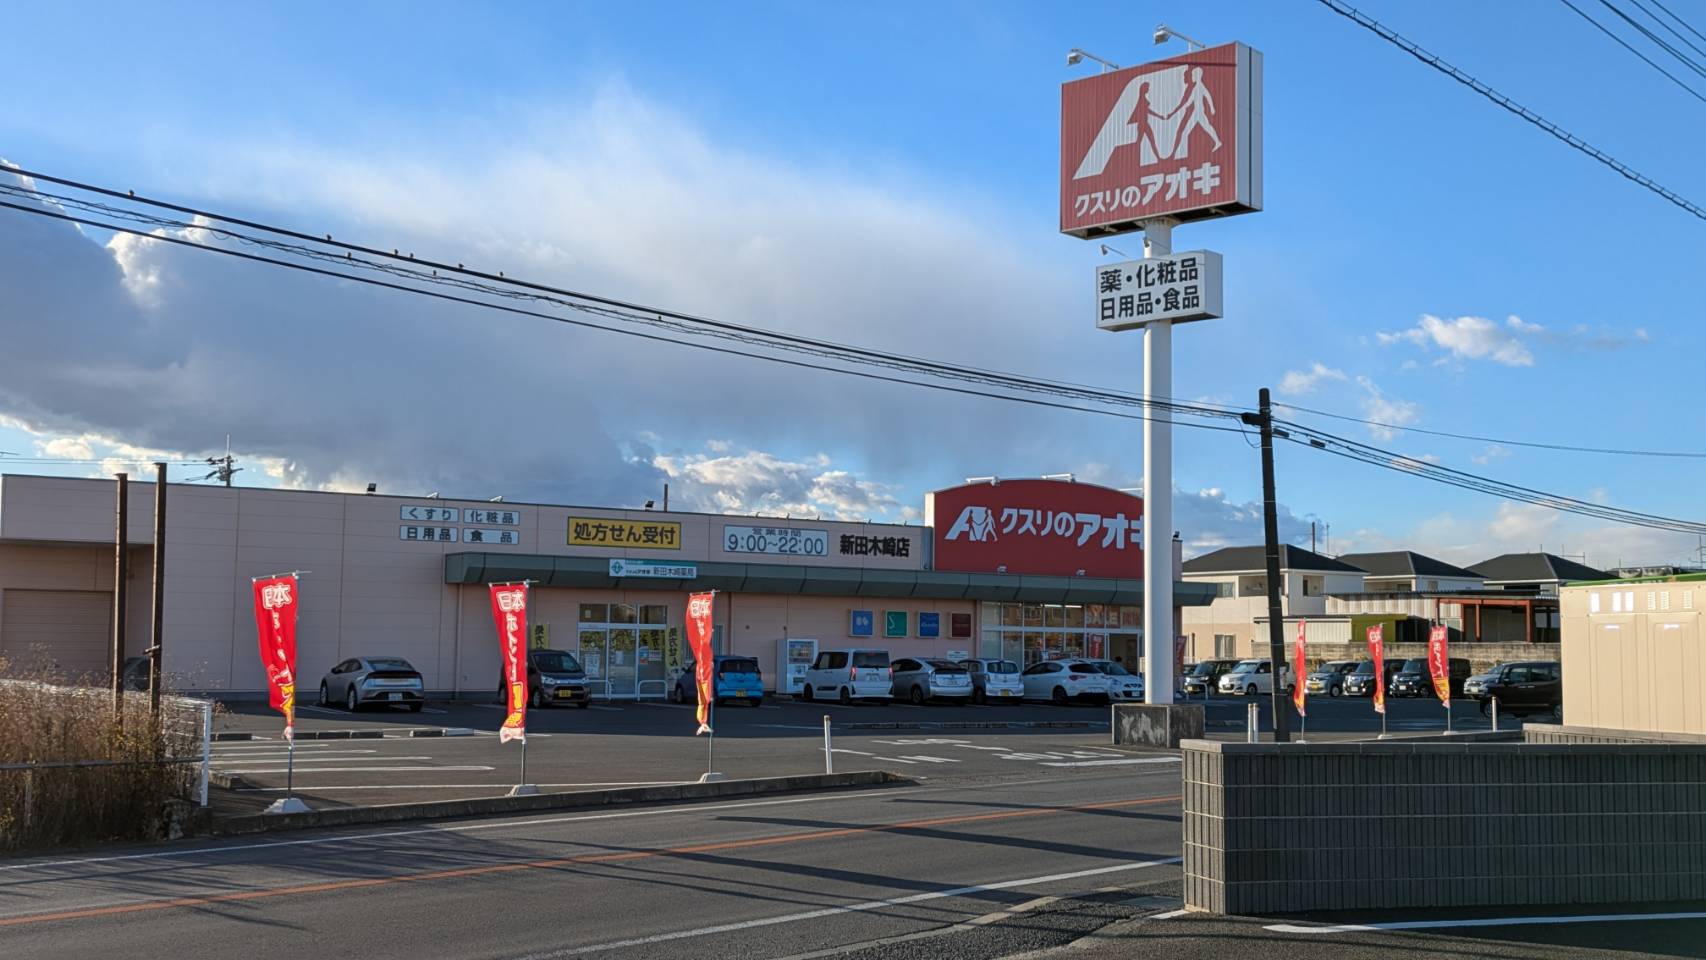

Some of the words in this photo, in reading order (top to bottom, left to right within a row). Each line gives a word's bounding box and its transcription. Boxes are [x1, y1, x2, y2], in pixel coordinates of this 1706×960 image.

[1075, 162, 1221, 219] クスリのアオキ
[1100, 257, 1199, 294] 薬・化粧品
[1100, 284, 1201, 321] 日用品・食品
[407, 507, 453, 522] くすり
[470, 510, 514, 525] 化粧品
[405, 526, 452, 541] 日用品
[470, 528, 513, 544] 食品
[573, 522, 676, 546] 処方せん受付
[751, 528, 803, 538] 営業時間
[839, 534, 911, 558] 新田木崎店
